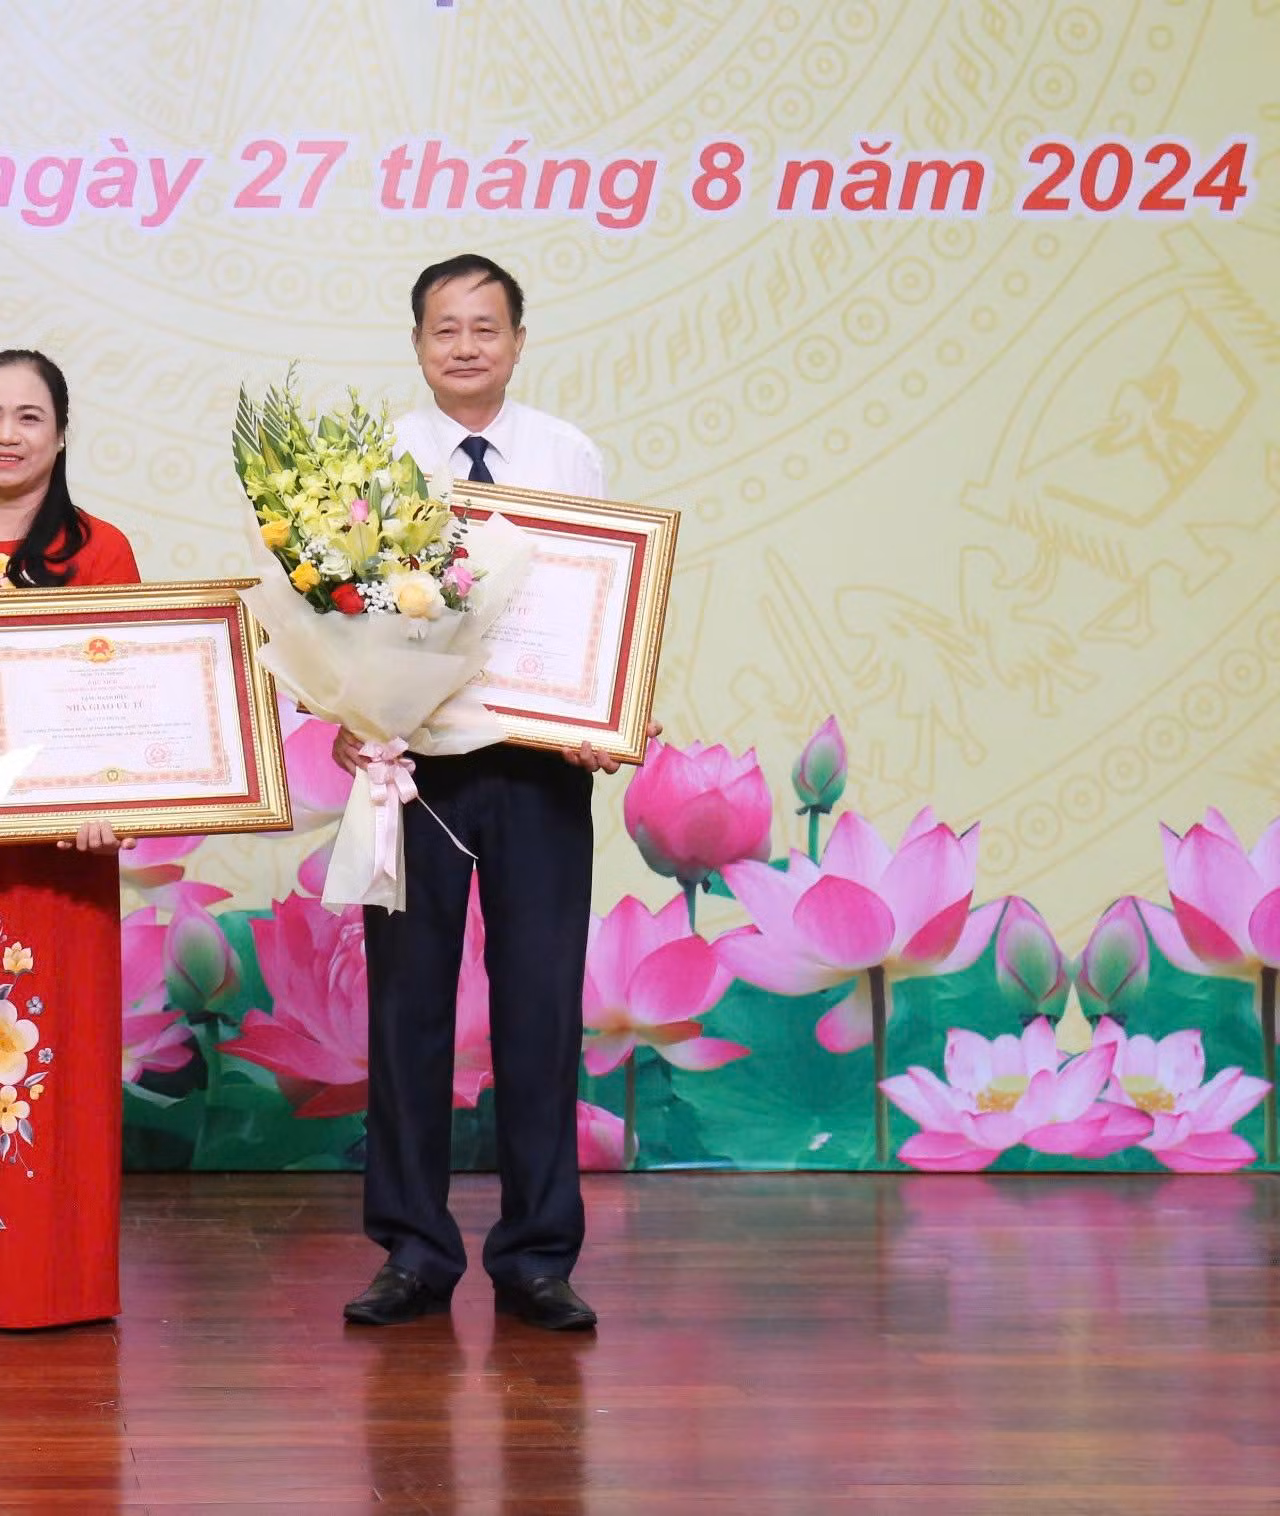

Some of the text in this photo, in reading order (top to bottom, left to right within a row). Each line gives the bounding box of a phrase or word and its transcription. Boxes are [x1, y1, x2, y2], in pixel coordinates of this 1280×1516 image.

[235, 139, 347, 209] 27
[381, 139, 657, 231] tháng
[691, 141, 745, 213] 8
[775, 139, 985, 213] năm
[1023, 141, 1250, 213] 2024
